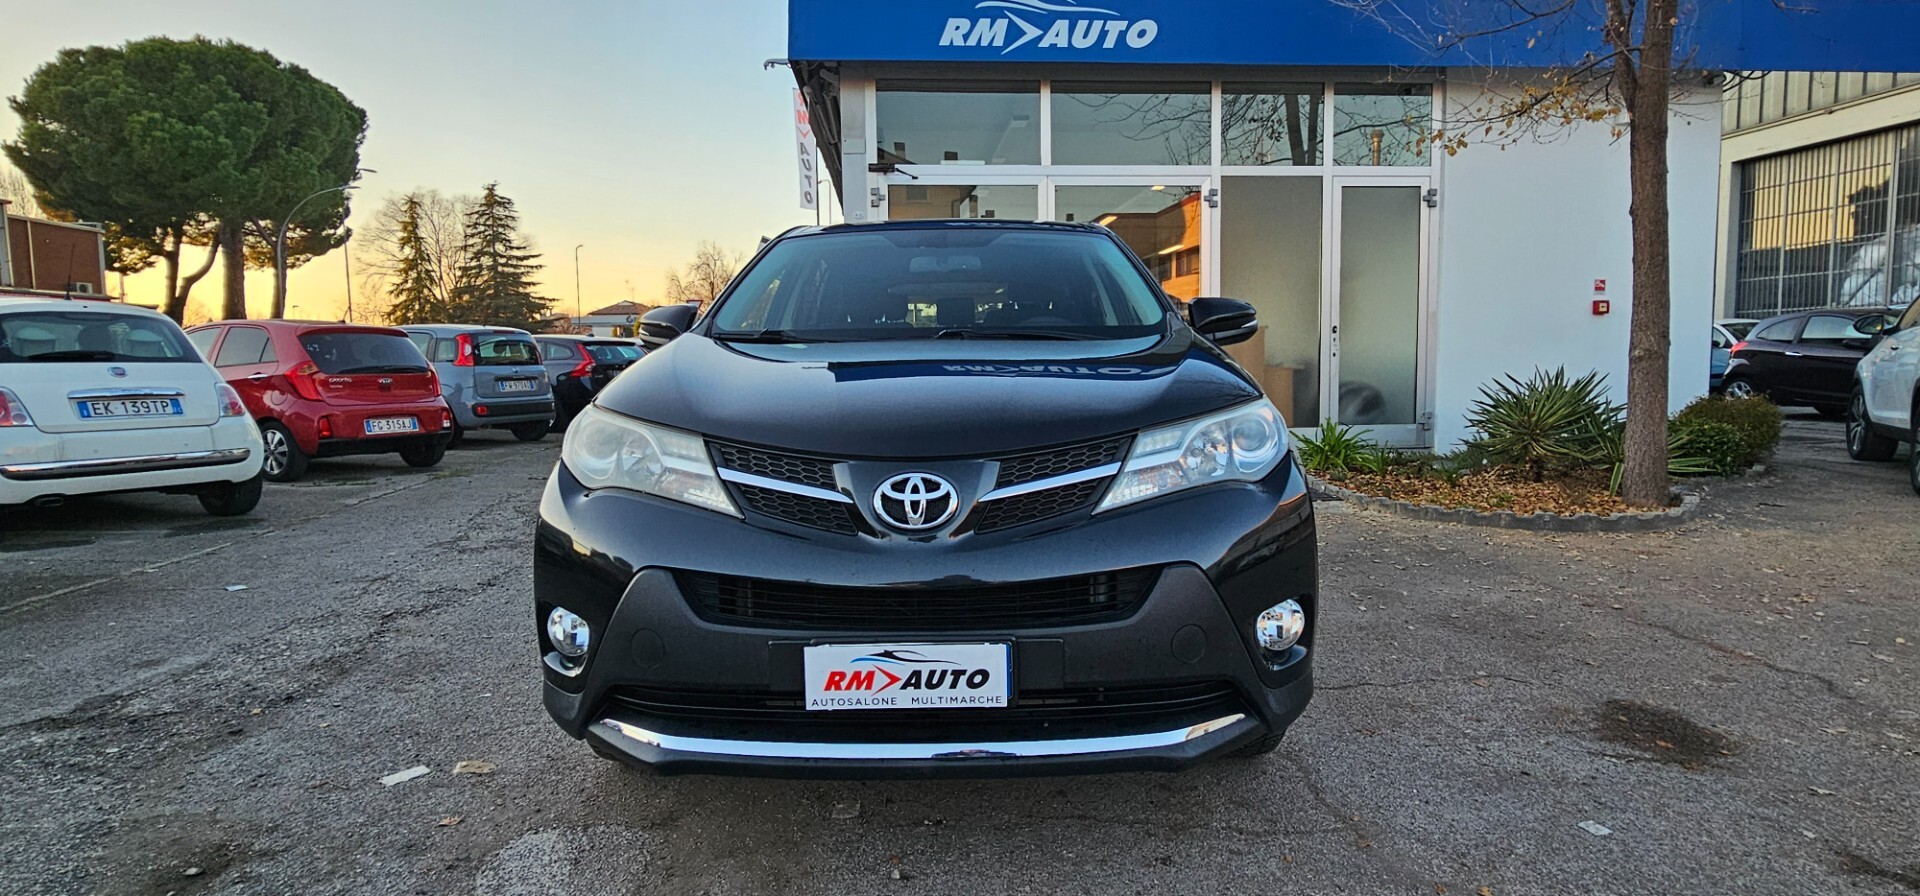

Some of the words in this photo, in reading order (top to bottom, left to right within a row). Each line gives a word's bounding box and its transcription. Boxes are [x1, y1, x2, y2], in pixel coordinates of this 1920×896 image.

[939, 18, 1009, 46] RM
[1038, 19, 1158, 49] AUTO
[91, 402, 114, 416] EK
[120, 400, 169, 414] 139TP
[372, 420, 383, 431] FG
[385, 419, 412, 430] 315AJ
[823, 670, 876, 692] RM
[899, 668, 990, 691] AUTO
[811, 697, 898, 707] AUTOSALONE
[911, 695, 1002, 705] MULTIMARCHE
